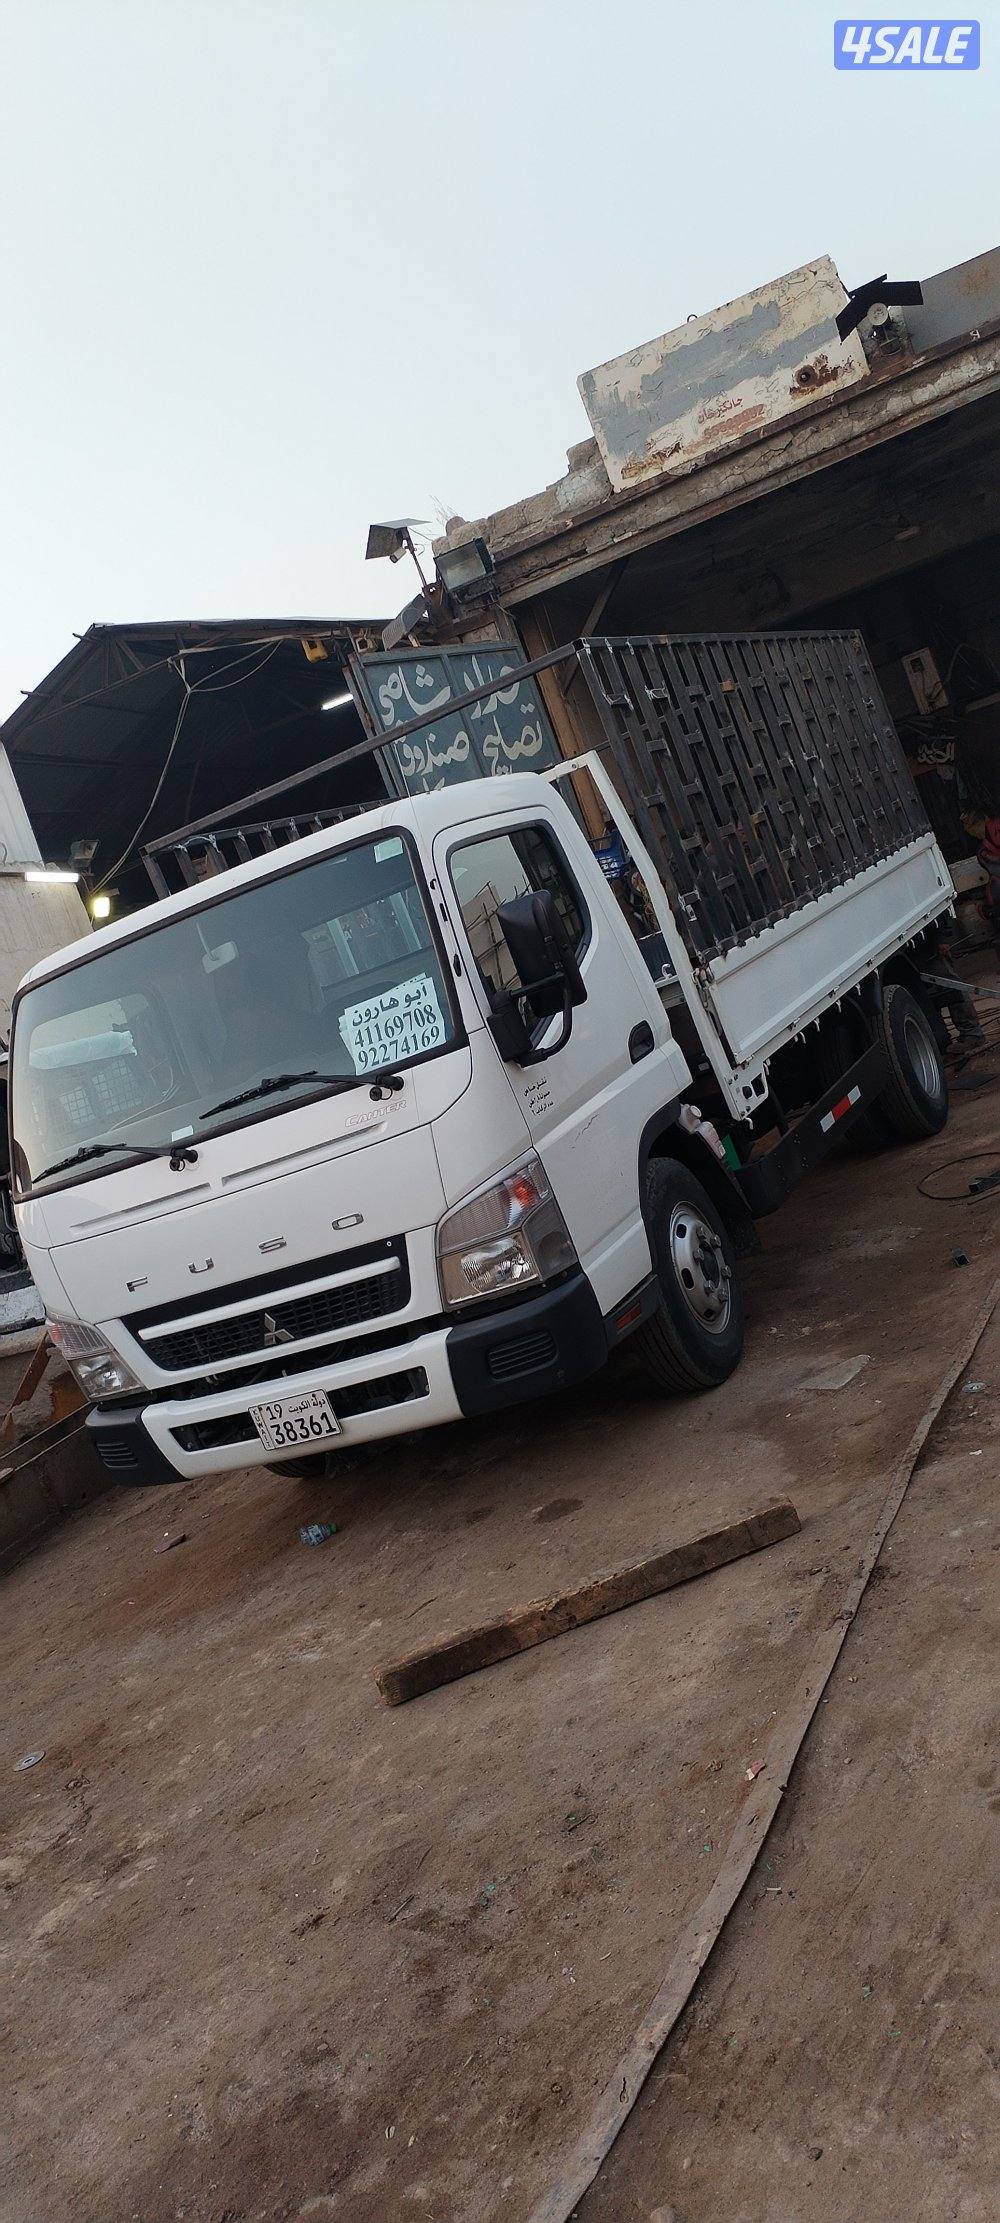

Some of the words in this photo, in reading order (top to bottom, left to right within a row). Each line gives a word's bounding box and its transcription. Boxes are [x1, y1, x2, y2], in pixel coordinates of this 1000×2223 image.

[352, 997, 400, 1026] هارون
[354, 1004, 437, 1048] 41169708
[358, 1025, 440, 1070] 92274169
[345, 1100, 407, 1127] CANTER
[126, 1212, 364, 1293] FUSO
[266, 1403, 282, 1421] 19
[288, 1400, 311, 1414] الكويت
[270, 1411, 336, 1446] 38361
